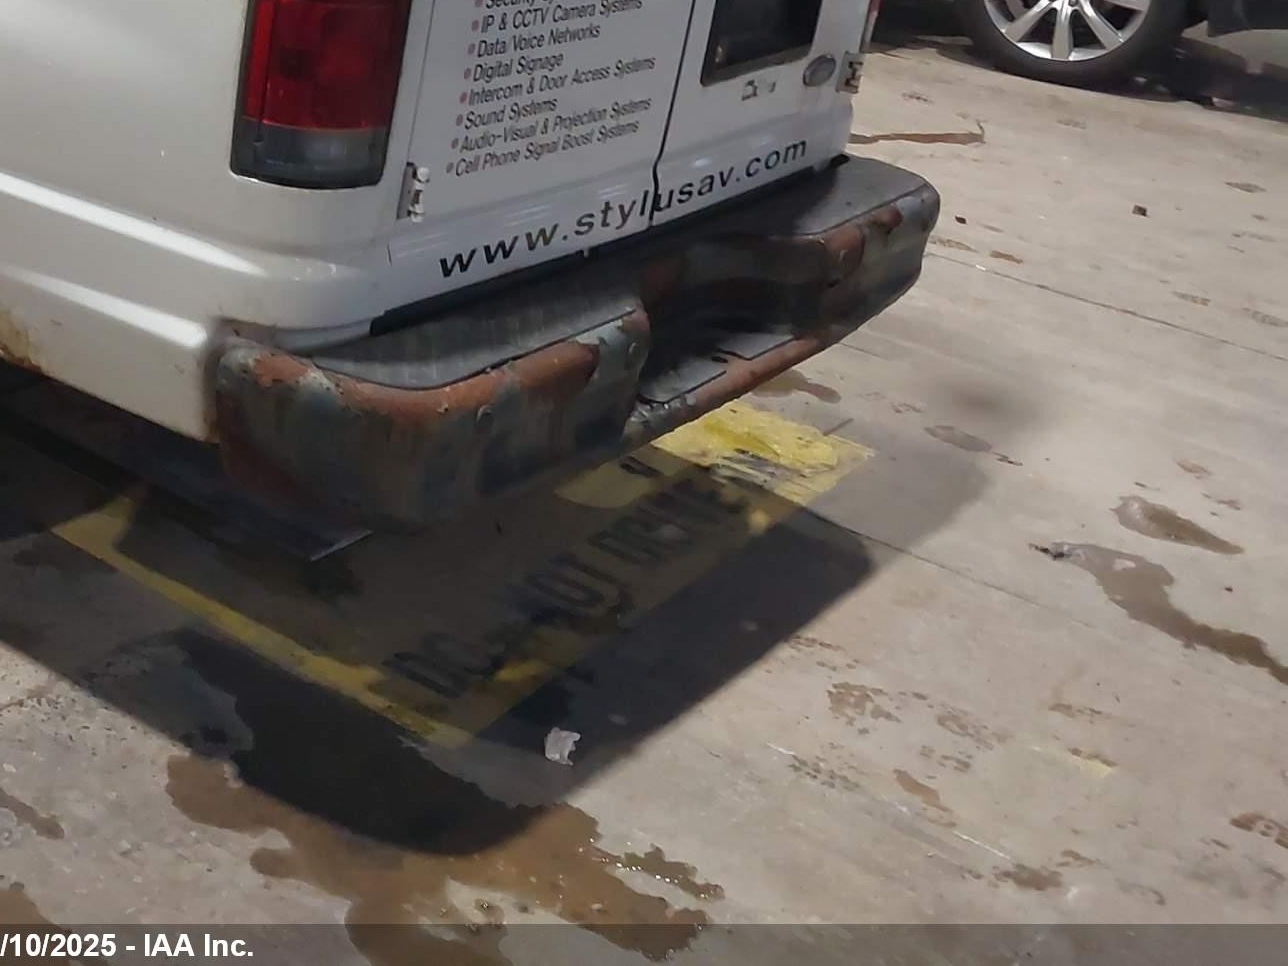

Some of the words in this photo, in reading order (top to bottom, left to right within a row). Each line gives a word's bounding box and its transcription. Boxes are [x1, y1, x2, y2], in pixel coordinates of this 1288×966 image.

[481, 14, 494, 34] IP
[498, 11, 507, 31] &
[512, 6, 548, 30] CCTV
[552, 2, 596, 23] Camera
[477, 37, 507, 58] Data
[512, 31, 544, 51] Voice
[548, 22, 600, 45] Networks
[468, 84, 523, 107] Intercom
[526, 77, 536, 95] &
[539, 73, 568, 92] Door
[570, 64, 611, 85] Access
[613, 57, 656, 78] Systems
[473, 58, 513, 83] Digital
[516, 52, 564, 76] Signage
[464, 107, 505, 130] Sound
[509, 98, 558, 122] Systems
[455, 154, 480, 177] Cell
[482, 148, 521, 171] Phone
[440, 139, 808, 278] www.stylusav.com
